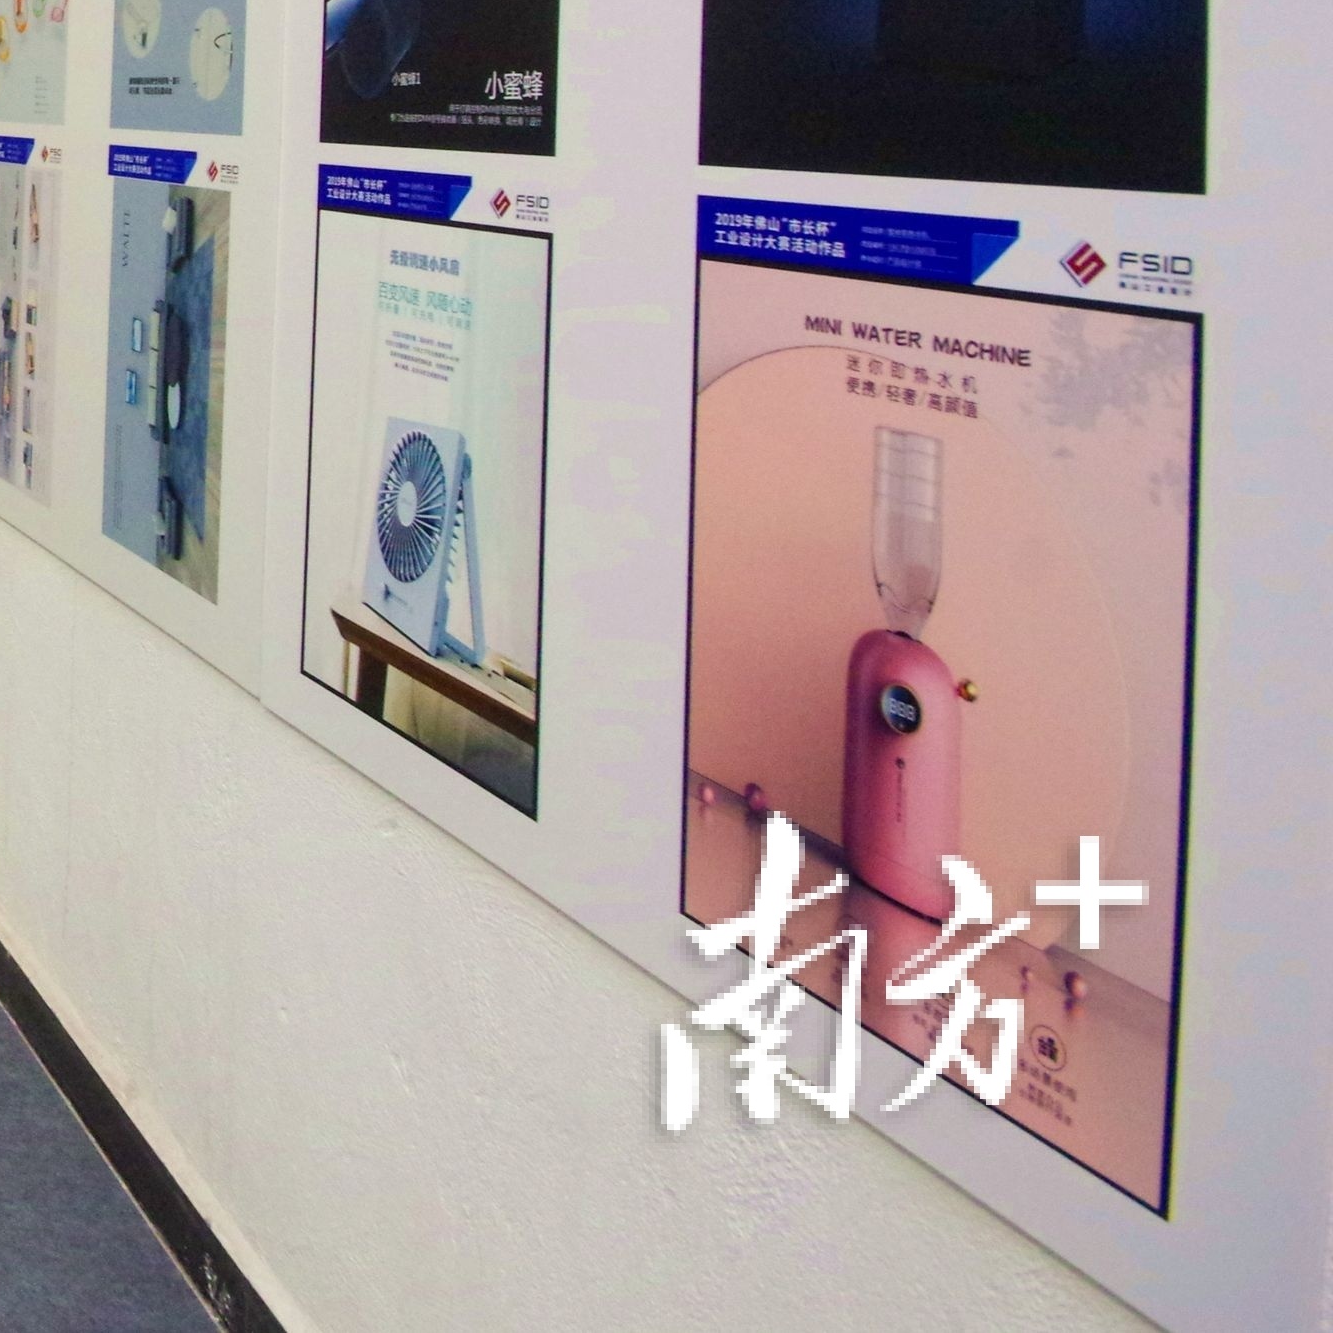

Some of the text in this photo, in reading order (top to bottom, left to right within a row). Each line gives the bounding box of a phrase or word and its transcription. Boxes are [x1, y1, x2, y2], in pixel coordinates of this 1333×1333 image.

[484, 70, 544, 101] 小蜜蜂
[515, 194, 550, 210] FSID
[714, 229, 846, 259] 工业设计大赛活动作品
[1118, 251, 1193, 276] FSID
[804, 314, 1032, 367] MINI WATER MACHINE
